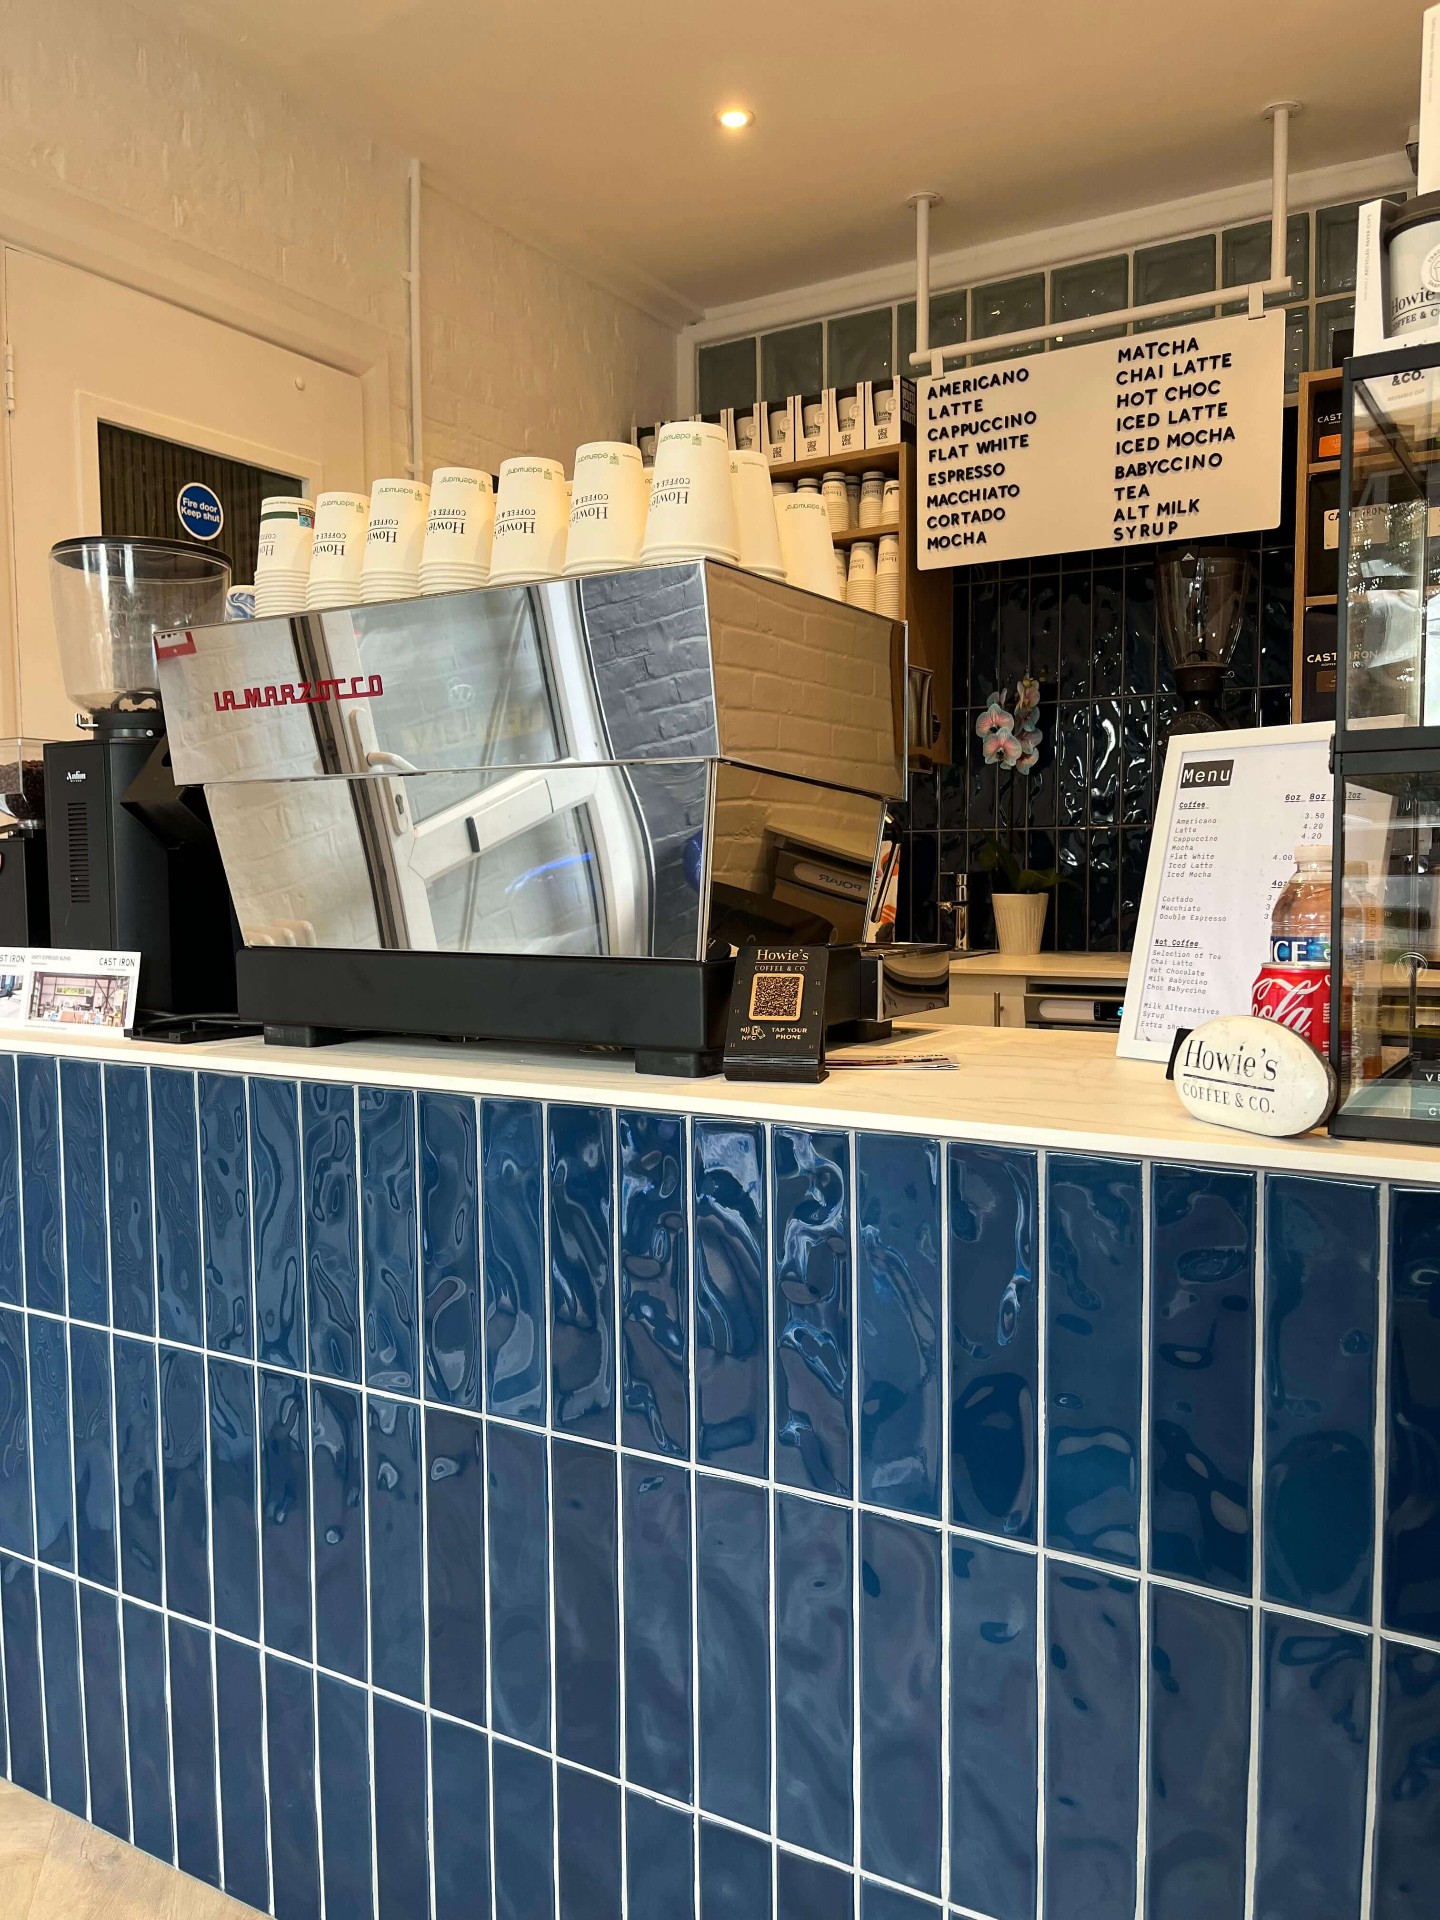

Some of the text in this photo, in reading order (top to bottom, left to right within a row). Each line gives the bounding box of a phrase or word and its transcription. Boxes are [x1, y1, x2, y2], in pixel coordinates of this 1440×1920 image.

[1118, 337, 1199, 363] MATCHA
[1116, 352, 1232, 385] CHAI LATTE
[927, 368, 1029, 400] AMERICANO
[1116, 380, 1221, 408] HOT CHOC
[928, 399, 984, 420] LATTE
[1116, 402, 1228, 432] ICED LATTE
[1318, 412, 1342, 423] CAST
[928, 411, 1036, 441] CAPPUCCINO
[928, 434, 1030, 463] FLAT WHITE
[1116, 426, 1236, 455] ICED MOCHA
[928, 462, 1006, 486] ESPRESSO
[1115, 452, 1222, 480] BABYCCINO
[661, 478, 690, 488] COFFEE
[580, 494, 608, 503] COFFEE
[927, 484, 1020, 508] MACCHIATO
[1114, 484, 1150, 500] TEA
[182, 497, 217, 513] Fire door
[1114, 498, 1200, 522] ALT MILK
[181, 506, 220, 523] Keep shut
[507, 509, 536, 518] COFFEE
[927, 507, 1006, 529] CORTADO
[1114, 521, 1178, 541] SYRUP
[927, 531, 987, 550] MOCHA
[1306, 652, 1337, 663] CAST
[214, 674, 384, 712] LA MARZOCCO
[1182, 768, 1231, 784] Menu
[1309, 792, 1326, 800] 8oz
[1346, 792, 1361, 800] 2oz
[1154, 938, 1199, 947] Not Coffee
[10, 955, 26, 963] IRON
[99, 957, 136, 967] CAST IRON
[756, 949, 809, 960] Howie's
[1152, 950, 1190, 958] Selection
[1166, 968, 1205, 977] Chocolate
[1169, 977, 1208, 986] Babyccino
[1168, 986, 1206, 994] Babyccino
[1142, 1011, 1165, 1019] Syrup
[1165, 1004, 1220, 1016] Alternatives
[1140, 1021, 1163, 1029] Extra
[1183, 1040, 1279, 1082] Howie's
[1182, 1082, 1275, 1113] COFFEE & CO.
